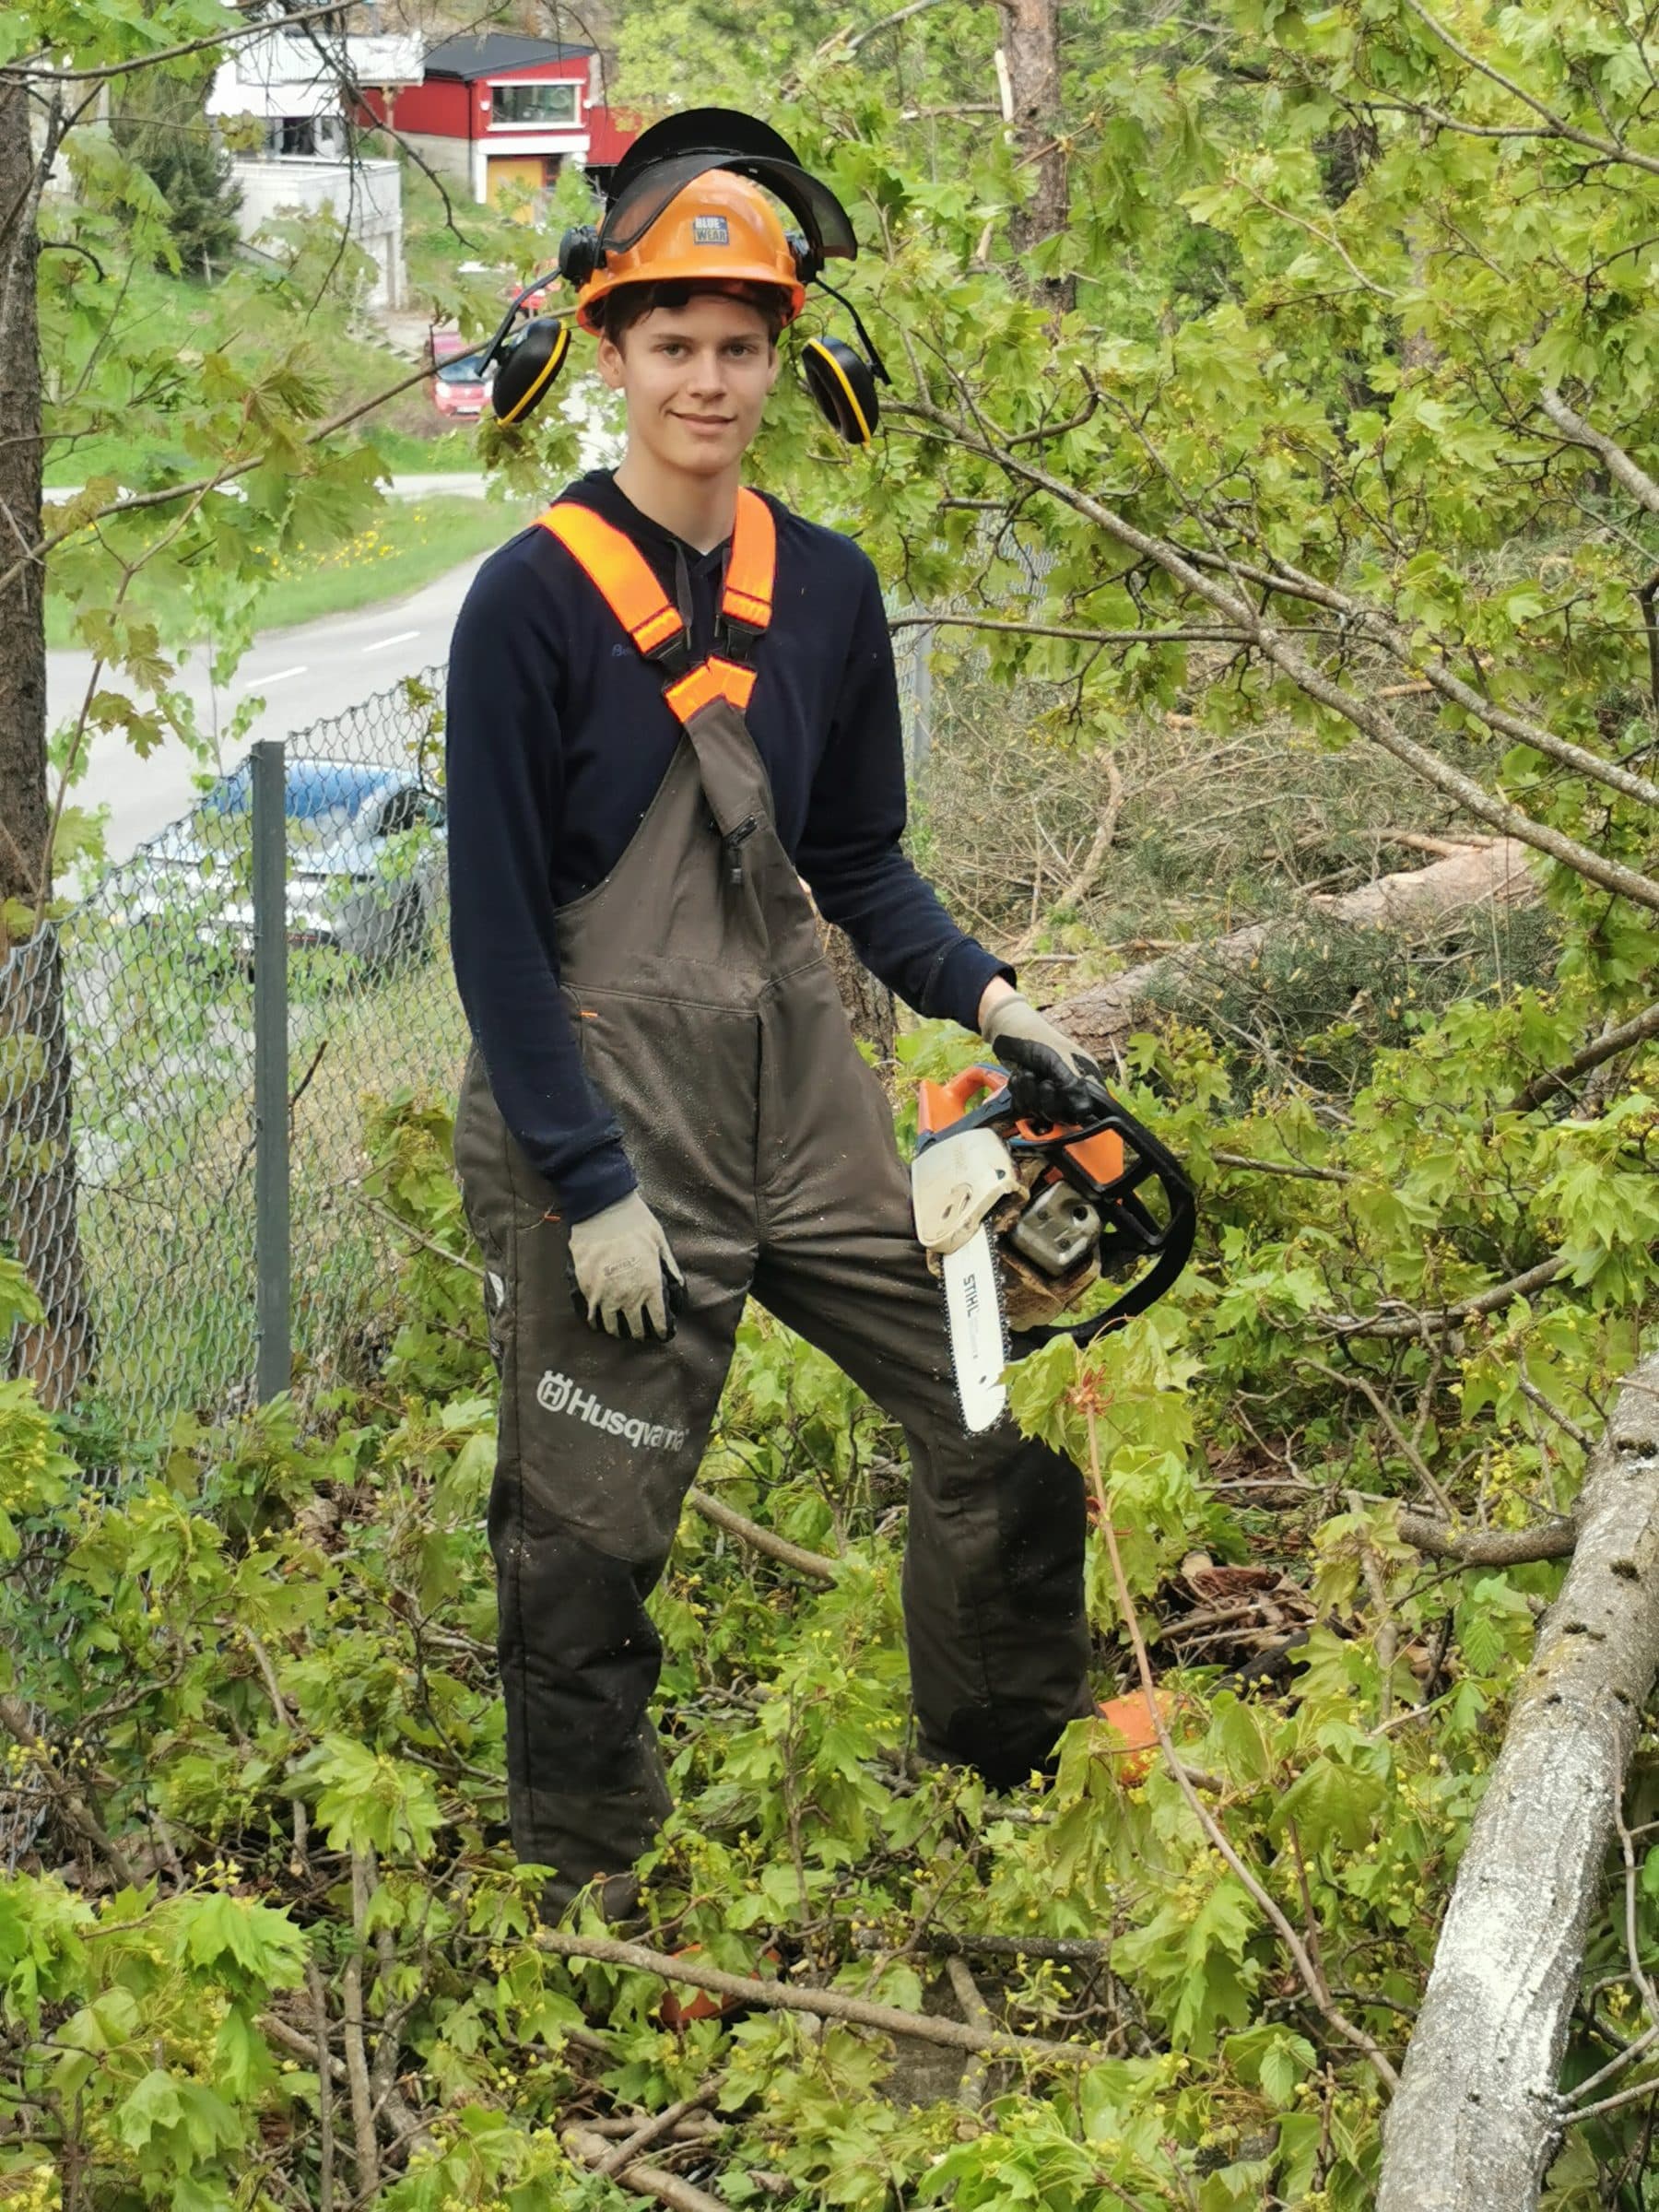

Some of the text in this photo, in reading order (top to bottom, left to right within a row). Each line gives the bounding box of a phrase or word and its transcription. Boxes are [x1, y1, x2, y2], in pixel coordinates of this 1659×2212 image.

[695, 217, 720, 229] BLUE
[696, 229, 726, 241] WEAR
[962, 1274, 979, 1318] STIHL
[566, 1387, 685, 1452] Husqvarna
